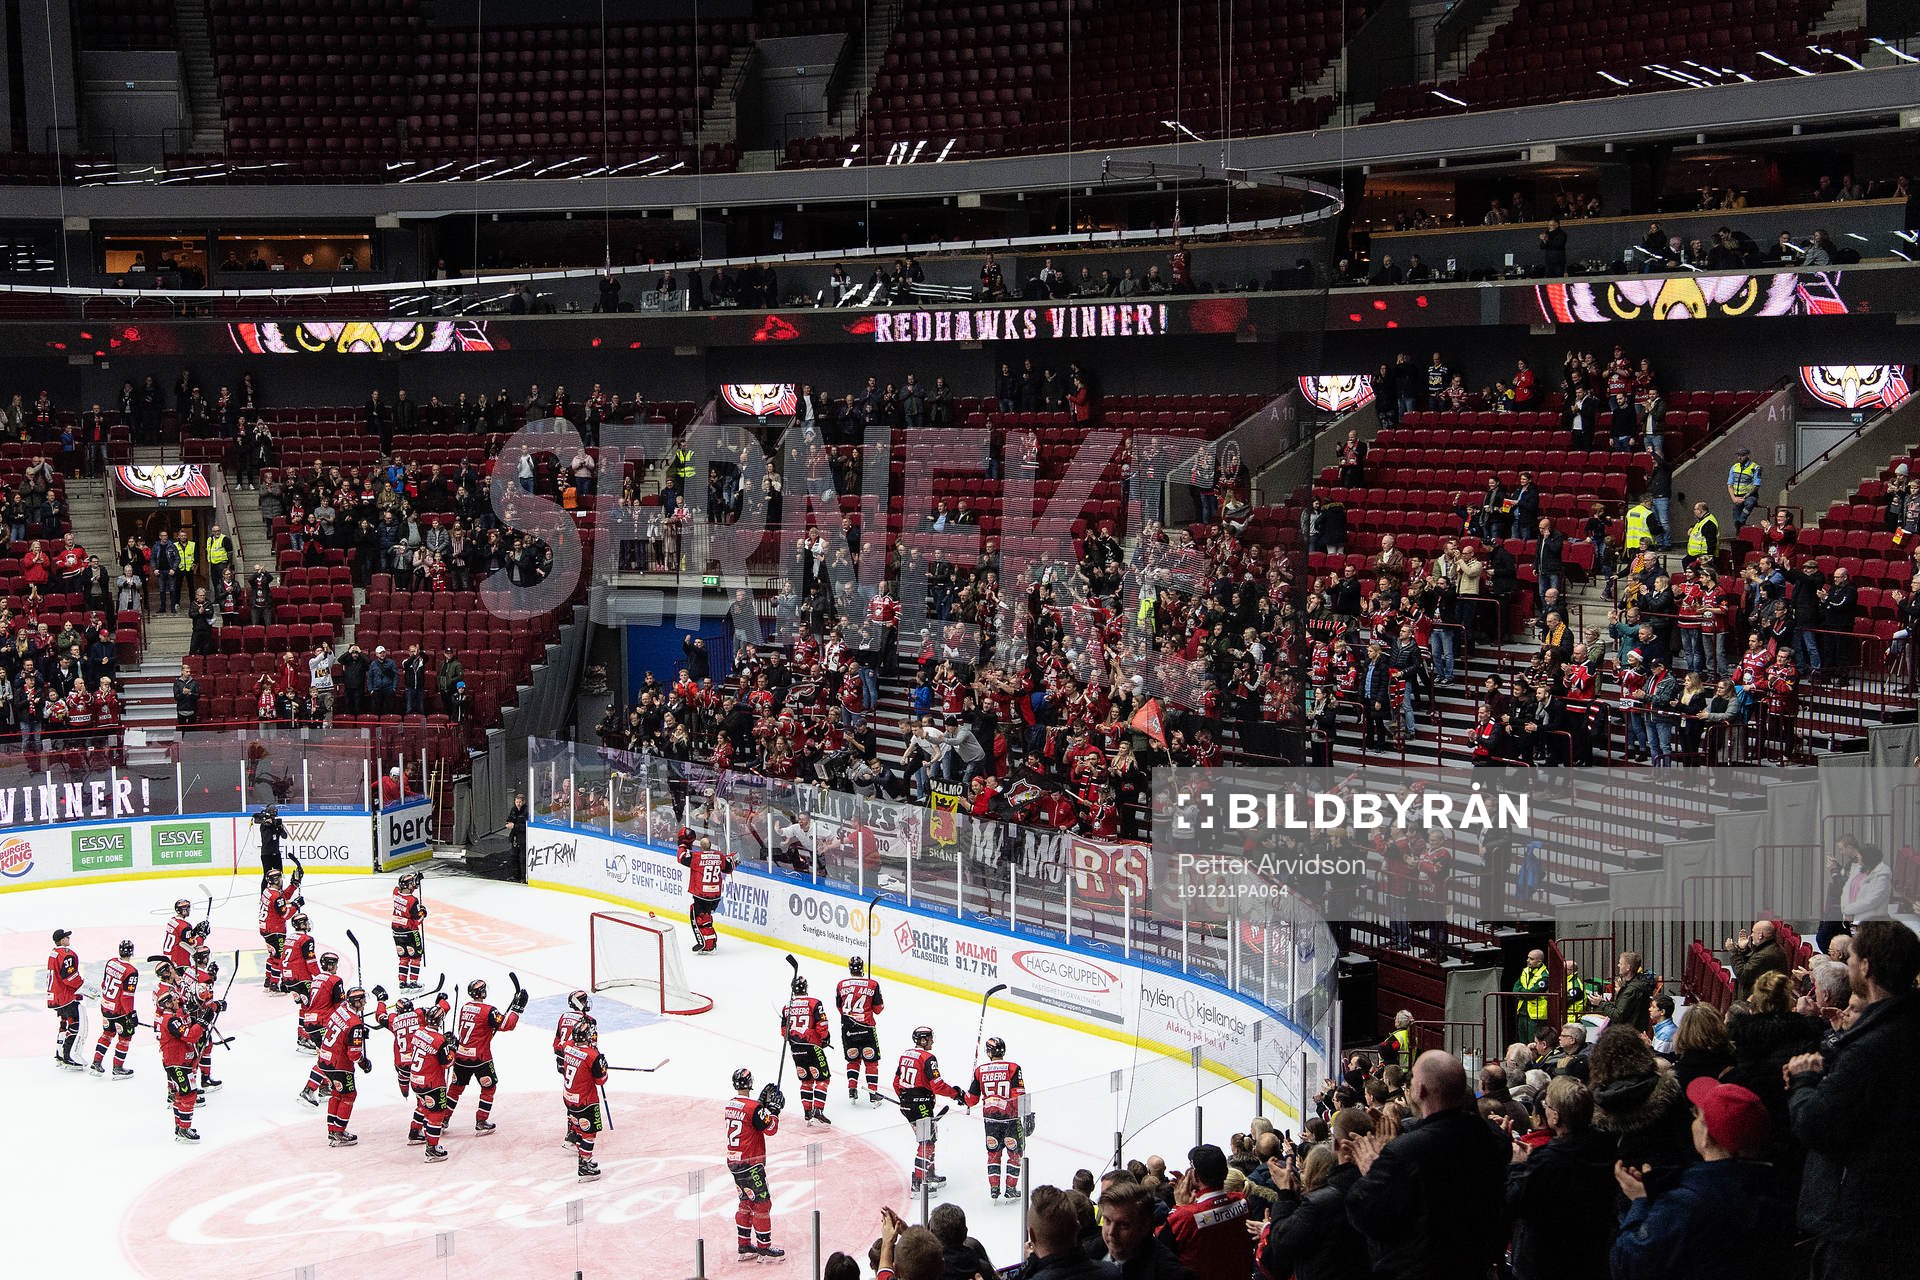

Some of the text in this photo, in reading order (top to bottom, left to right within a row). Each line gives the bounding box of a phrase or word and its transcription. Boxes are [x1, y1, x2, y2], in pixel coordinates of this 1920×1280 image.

[875, 303, 1169, 342] REDHAWKS VINNER!
[1767, 404, 1792, 422] A 11
[929, 778, 963, 797] MALMÖ
[79, 834, 125, 852] ESSVE
[159, 830, 204, 847] ESSVE
[0, 842, 31, 860] BURGER
[82, 854, 123, 865] GET IT DONE
[161, 849, 203, 860] GET IT DONE
[1, 850, 32, 872] KING
[605, 858, 618, 871] LA
[631, 859, 683, 882] SPORTRESOR
[632, 873, 655, 889] EVENT
[726, 882, 769, 908] ANTENN
[752, 908, 768, 926] AB
[802, 923, 826, 940] Sveriges
[827, 929, 844, 943] lokala
[912, 930, 949, 956] ROCK
[956, 940, 998, 963] MALMÖ
[63, 957, 74, 968] 37
[912, 949, 949, 966] KLASSIKER
[956, 956, 998, 979] 91.7 FM
[1026, 956, 1107, 987] HAGA GRUPPEN
[128, 976, 139, 986] 95
[842, 993, 867, 1014] 44
[1141, 984, 1175, 1008] hylén
[1197, 1000, 1247, 1037] kjellander
[353, 1029, 364, 1038] 63
[981, 1072, 1007, 1082] EKBERG
[1212, 1201, 1249, 1221] bravida
